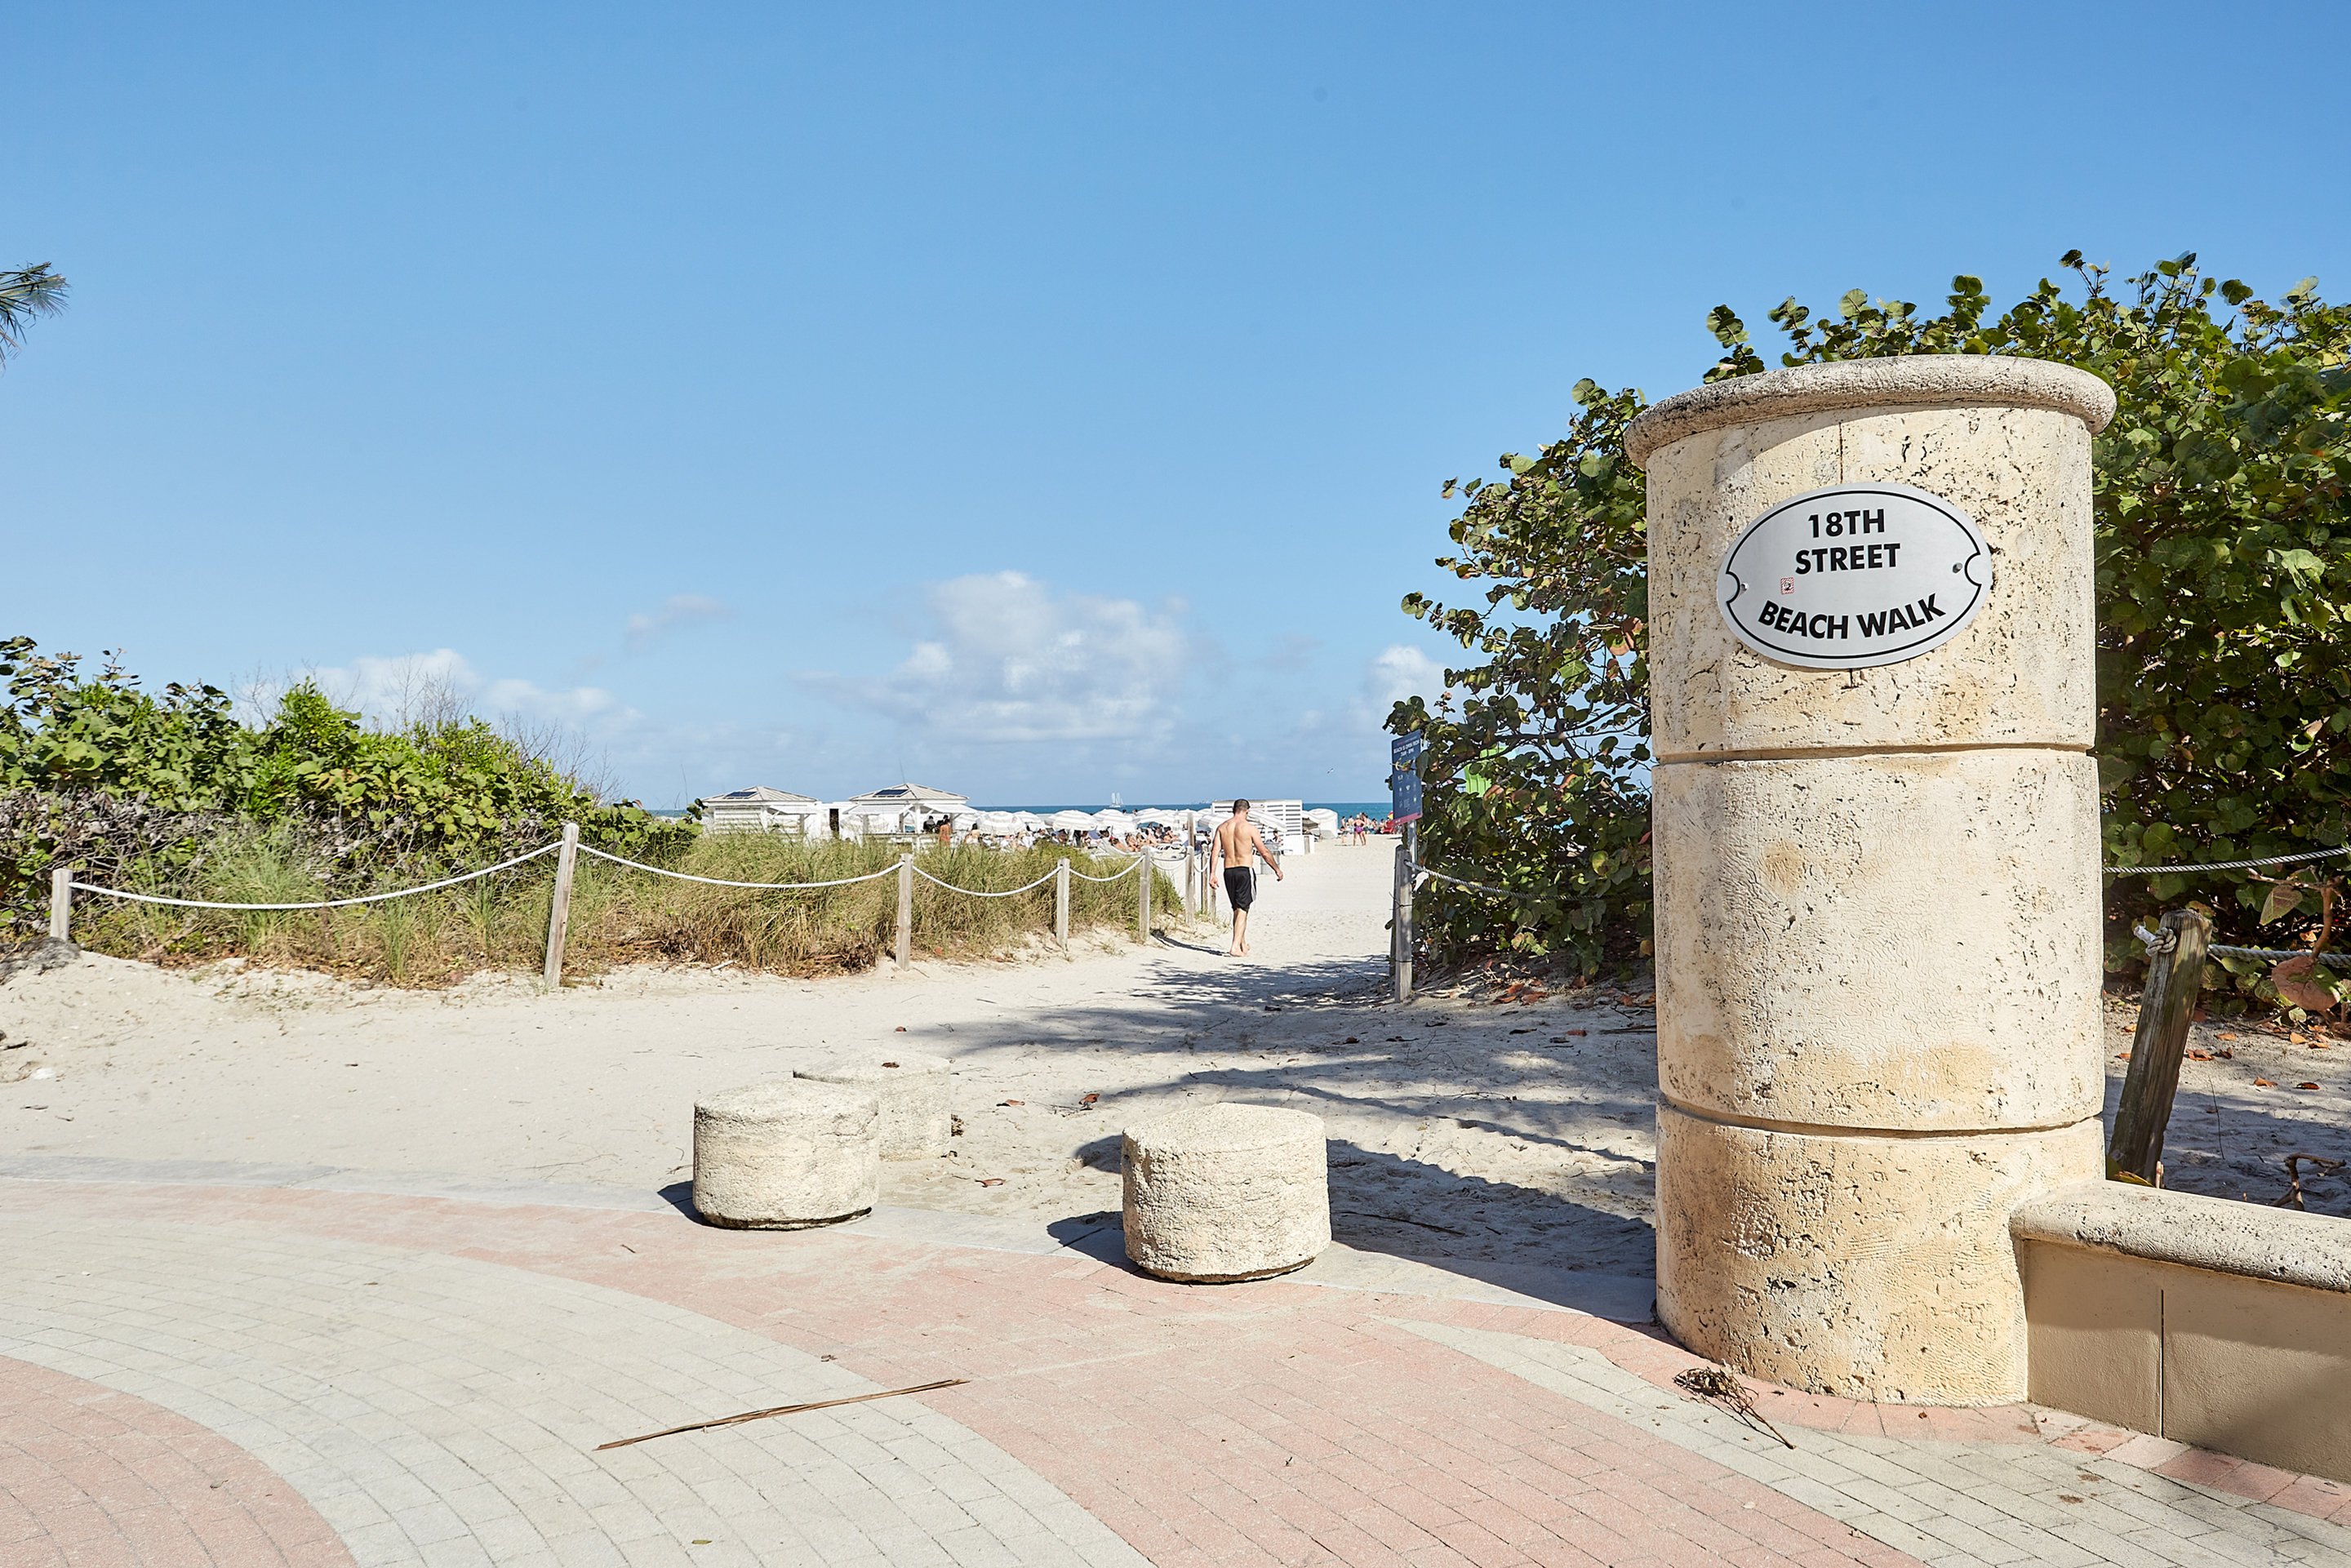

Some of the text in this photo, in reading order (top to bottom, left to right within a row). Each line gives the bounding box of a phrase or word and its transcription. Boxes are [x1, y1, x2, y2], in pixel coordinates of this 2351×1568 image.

[1808, 509, 1885, 539] 18TH
[1795, 543, 1901, 575] STREET
[1758, 593, 1946, 639] BEACH WALK
